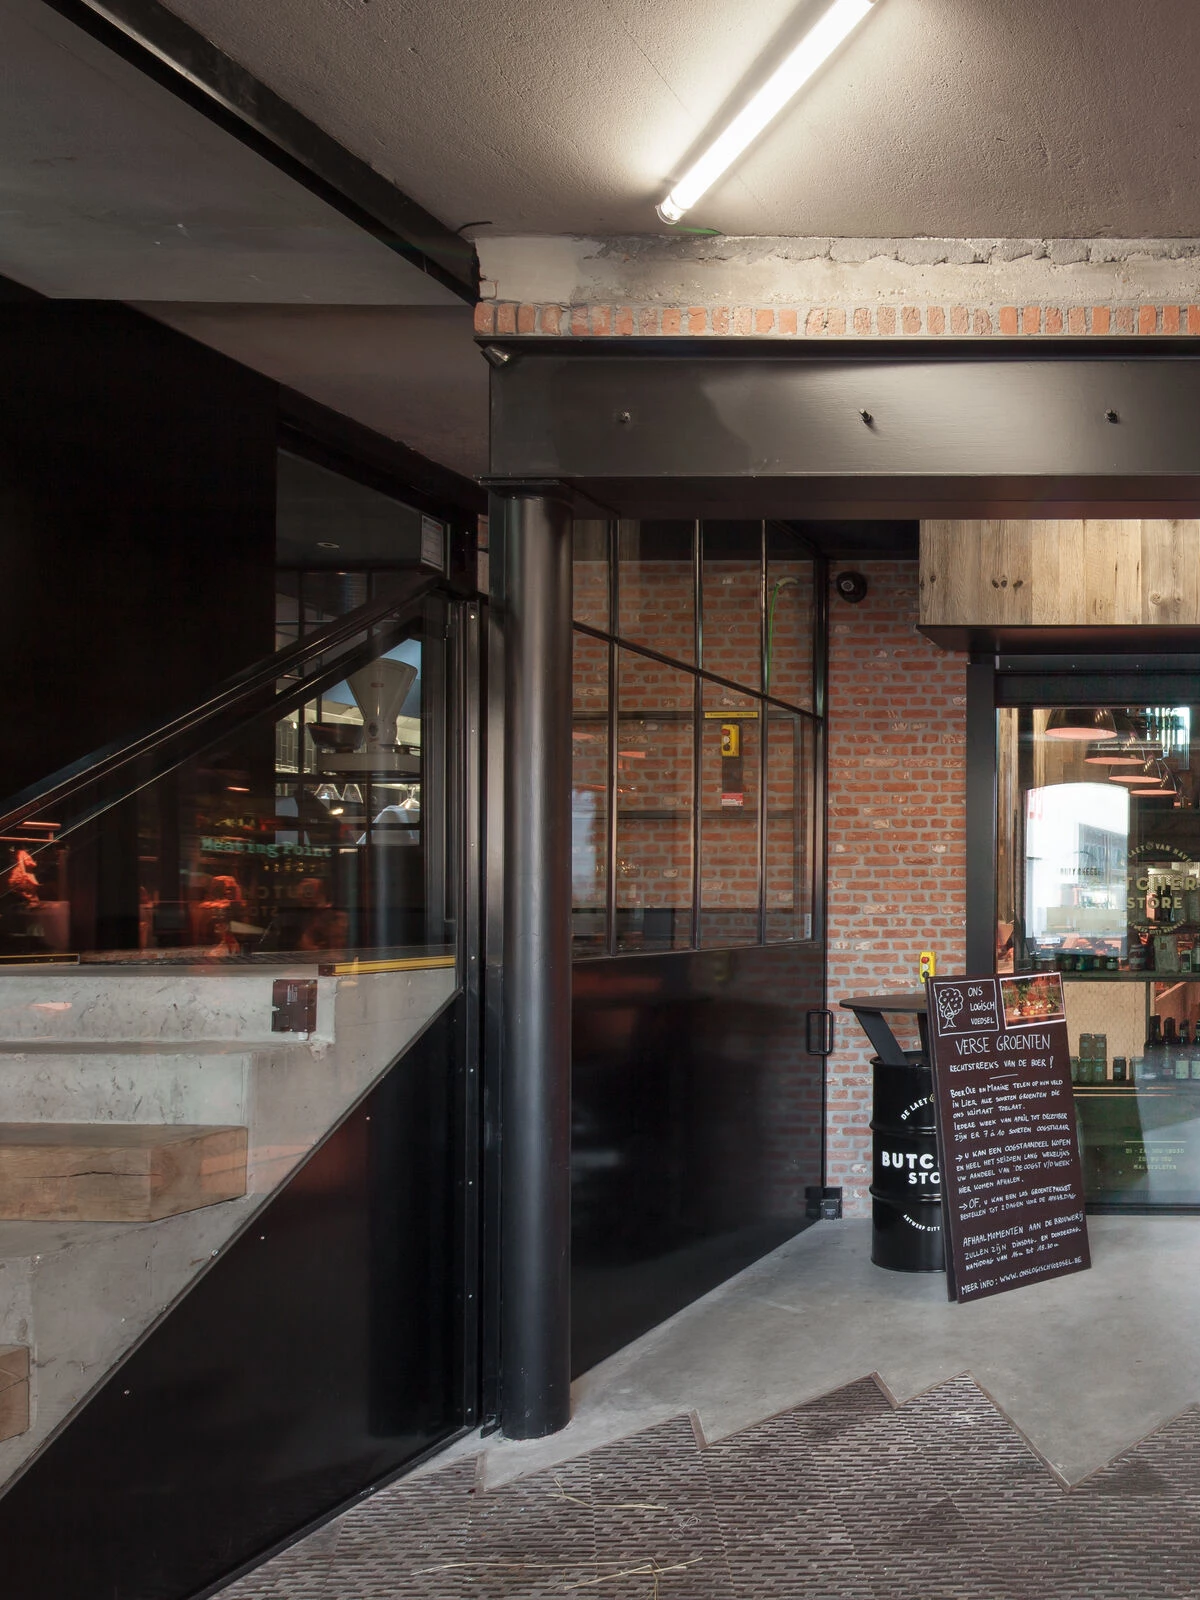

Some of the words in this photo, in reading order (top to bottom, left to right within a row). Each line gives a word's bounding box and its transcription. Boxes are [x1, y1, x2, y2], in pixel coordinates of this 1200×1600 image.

[1155, 843, 1172, 852] VAN
[1128, 897, 1182, 909] STORE
[968, 986, 984, 997] ONS
[970, 1016, 995, 1026] VOEDSEL
[955, 1037, 990, 1056] VERSE
[996, 1034, 1050, 1052] GROENTEN
[950, 1061, 1000, 1072] RECHTSTREEKS
[1018, 1059, 1027, 1067] DE
[1031, 1059, 1046, 1068] BOER
[900, 1109, 910, 1120] DE
[910, 1097, 928, 1111] LAET
[882, 1151, 940, 1169] BUTC
[970, 1170, 995, 1179] AANDEEL
[1024, 1162, 1042, 1170] OOGST
[974, 1182, 994, 1191] KOMEN
[960, 1209, 986, 1220] BESTELLEN
[903, 1214, 926, 1231] ANTWERP
[963, 1226, 1024, 1247] AFHAALMOMENTEN
[1028, 1222, 1041, 1231] AAN
[965, 1248, 989, 1260] ZULLEN
[961, 1283, 978, 1295] MEER
